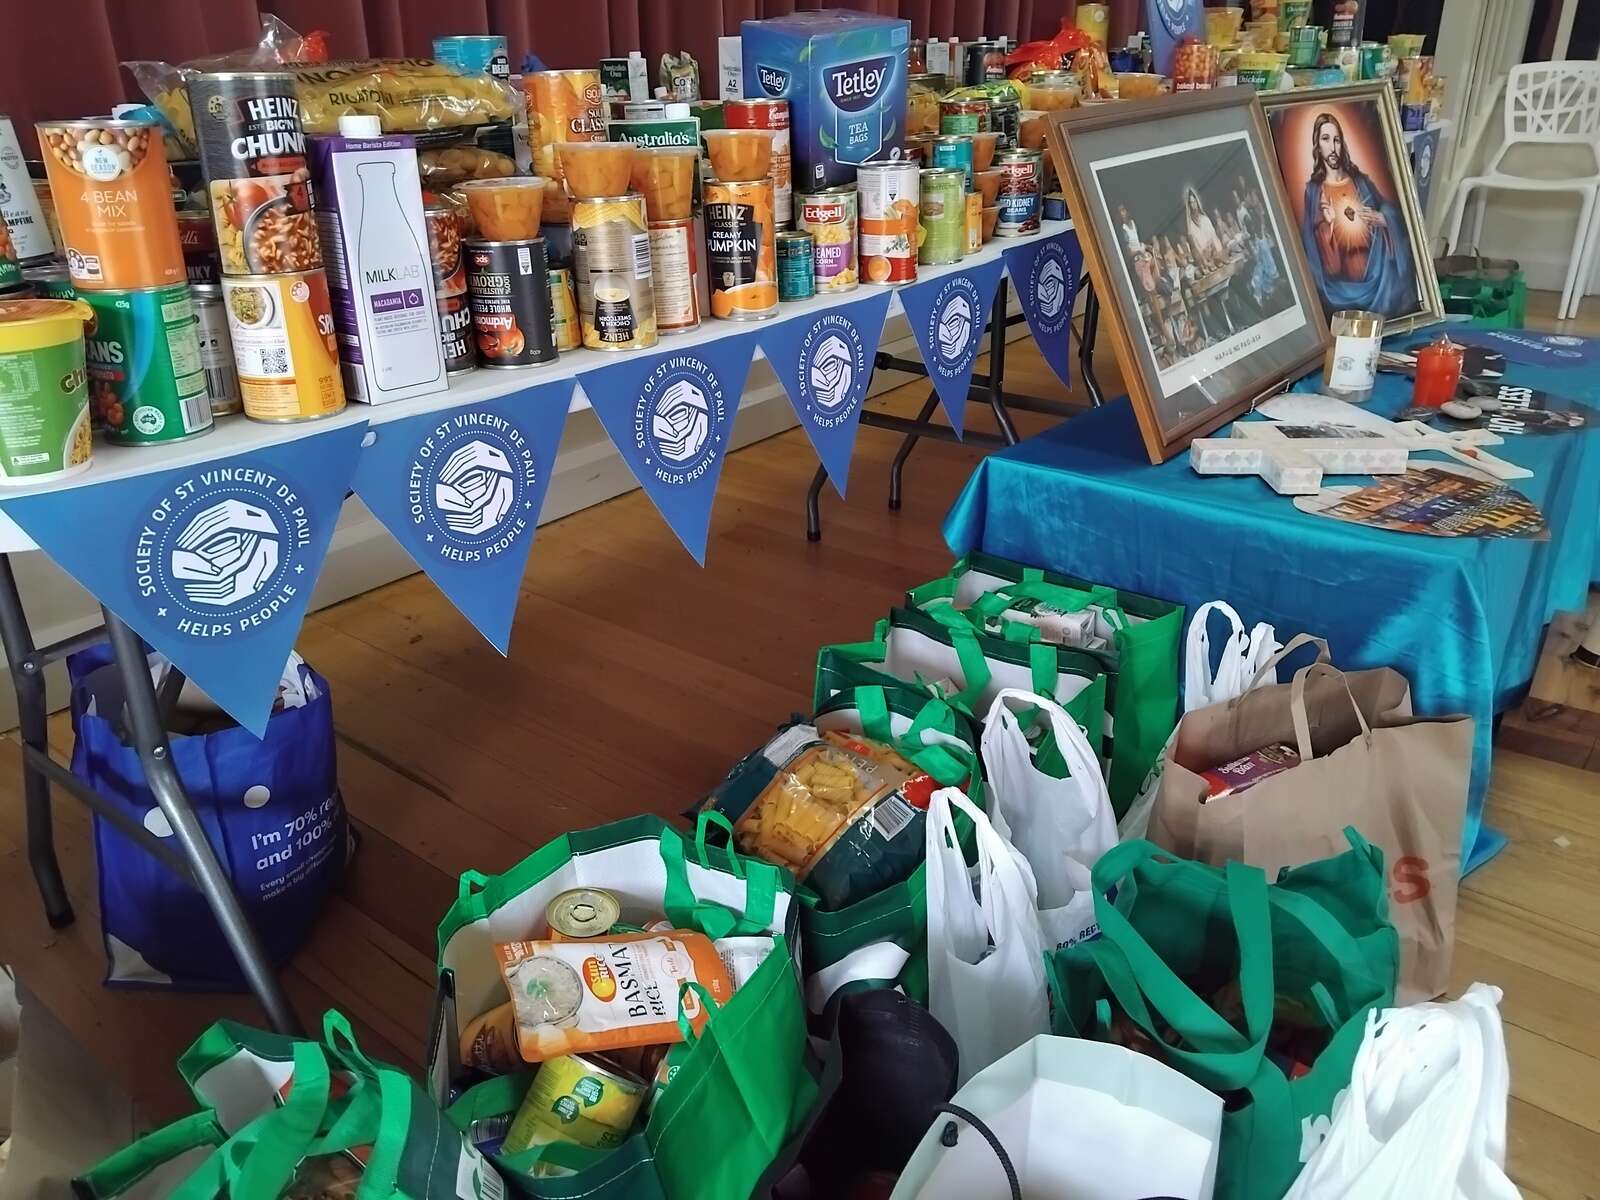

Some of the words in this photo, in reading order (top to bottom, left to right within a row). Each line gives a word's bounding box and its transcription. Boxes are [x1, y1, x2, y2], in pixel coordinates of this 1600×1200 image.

[728, 80, 737, 88] A2
[761, 69, 786, 92] Tetley
[833, 67, 887, 97] Tetley
[247, 97, 299, 122] HEINZ
[617, 130, 690, 147] Australia's
[849, 121, 869, 135] TEA
[849, 133, 869, 145] BAGS
[81, 191, 90, 203] 4
[94, 190, 138, 204] BEAN
[97, 205, 127, 218] MIX
[710, 205, 746, 221] HEINZ
[805, 206, 842, 221] Edgell
[712, 231, 742, 239] CREAMY
[602, 331, 630, 342] HEINZ
[799, 350, 807, 397] SOCIETY
[804, 332, 814, 348] OF
[812, 320, 822, 334] ST
[822, 315, 852, 331] VINCENT
[850, 328, 861, 344] DE
[856, 344, 865, 373] PAUL
[635, 395, 647, 449] SOCIETY
[644, 375, 656, 393] OF
[656, 363, 668, 378] ST
[669, 356, 708, 375] VINCENT
[707, 373, 719, 389] DE
[714, 390, 725, 423] PAUL
[813, 413, 834, 428] HELPS
[835, 396, 858, 427] PEOPLE
[409, 461, 426, 524] SOCIETY
[420, 437, 436, 458] OF
[435, 421, 452, 440] ST
[454, 413, 510, 432] VINCENT
[509, 429, 526, 449] DE
[521, 449, 537, 487] PAUL
[655, 467, 684, 485] HELPS
[686, 449, 717, 483] PEOPLE
[136, 526, 157, 597] SOCIETY
[152, 498, 173, 522] OF
[175, 479, 196, 500] ST
[200, 468, 277, 489] VINCENT
[276, 484, 297, 506] DE
[291, 506, 311, 548] PAUL
[440, 544, 481, 562] HELPS
[486, 517, 527, 558] PEOPLE
[177, 618, 233, 637] HELPS
[239, 583, 297, 632] PEOPLE
[251, 830, 282, 850] I'm
[284, 808, 318, 838] 70%
[256, 844, 293, 871] and
[295, 817, 332, 851] 100%
[643, 981, 667, 1017] RICE
